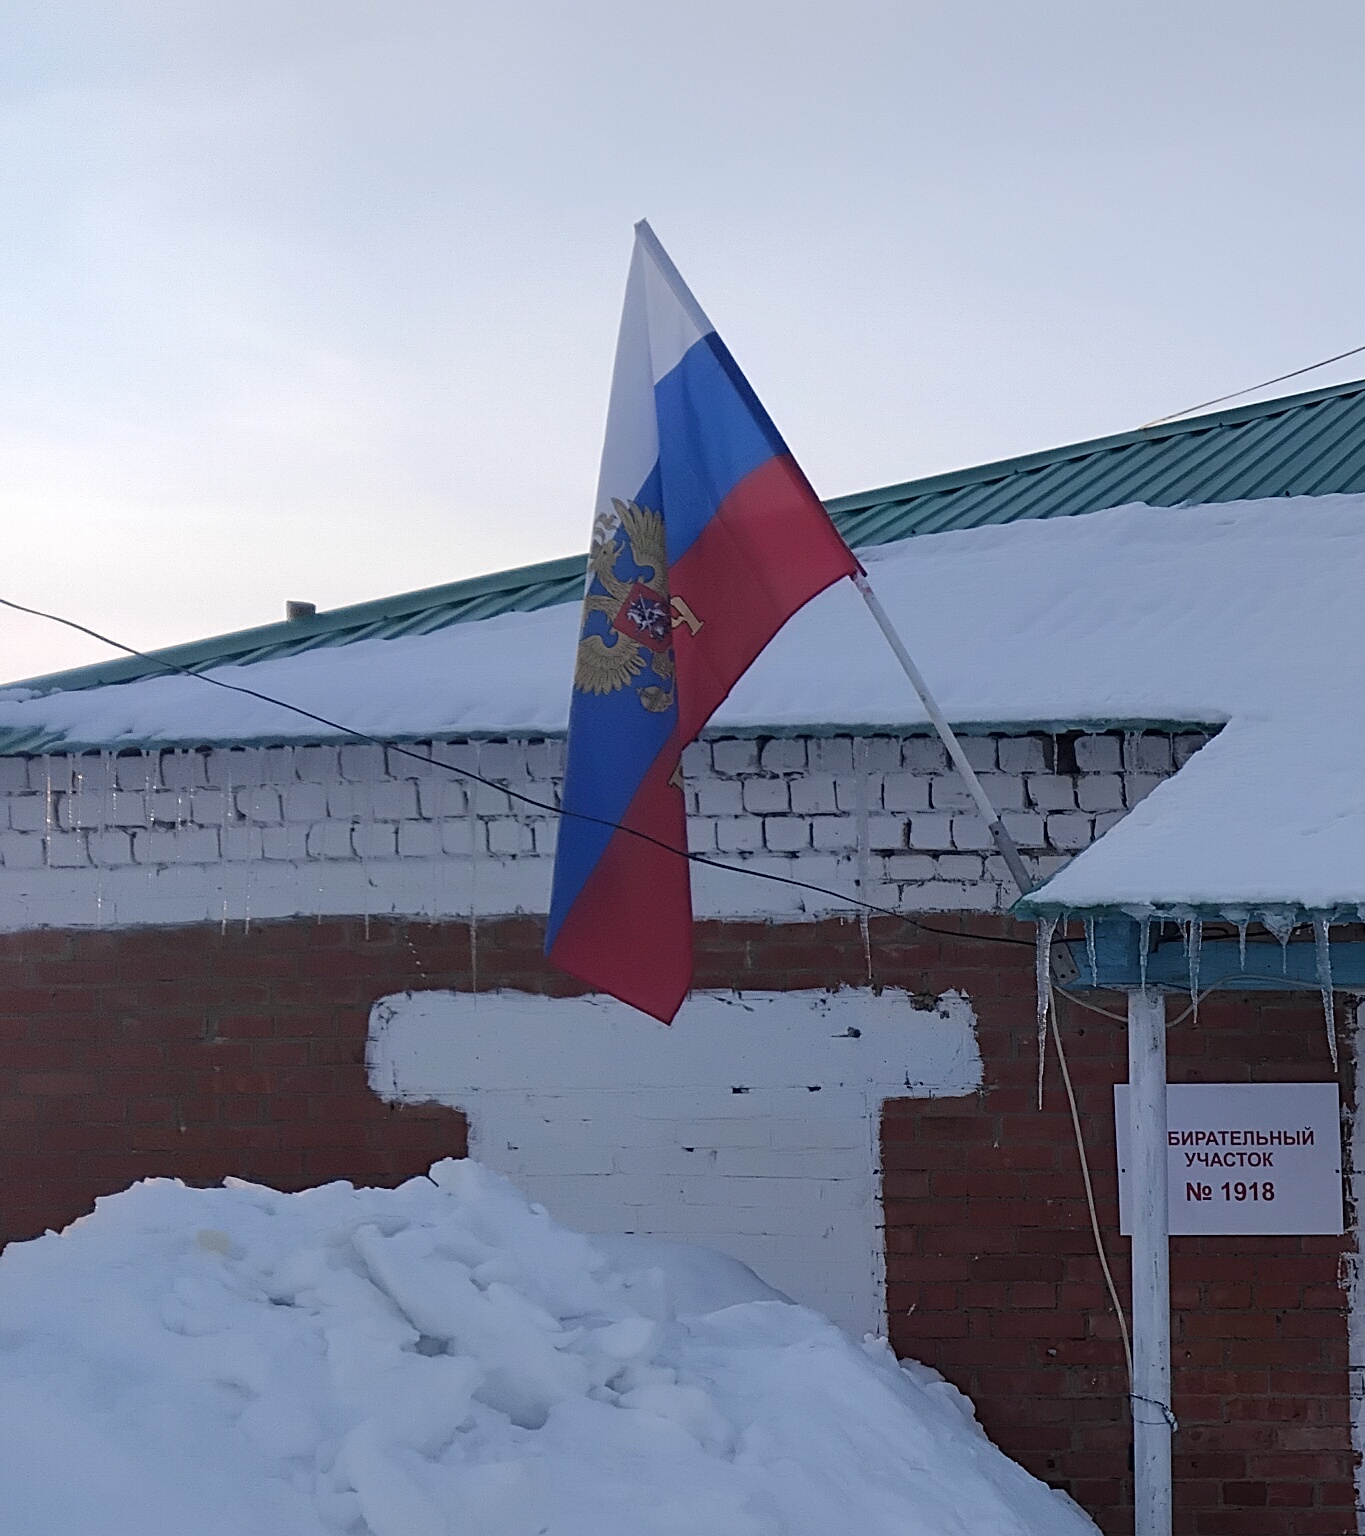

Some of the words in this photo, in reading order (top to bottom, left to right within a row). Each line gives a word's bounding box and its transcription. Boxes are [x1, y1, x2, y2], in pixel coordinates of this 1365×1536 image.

[1168, 1127, 1315, 1147] БИРАТЕЛЬНЫЙ
[1184, 1152, 1274, 1168] УЧАСТОК
[1186, 1182, 1213, 1202] №
[1220, 1181, 1275, 1202] 1918
